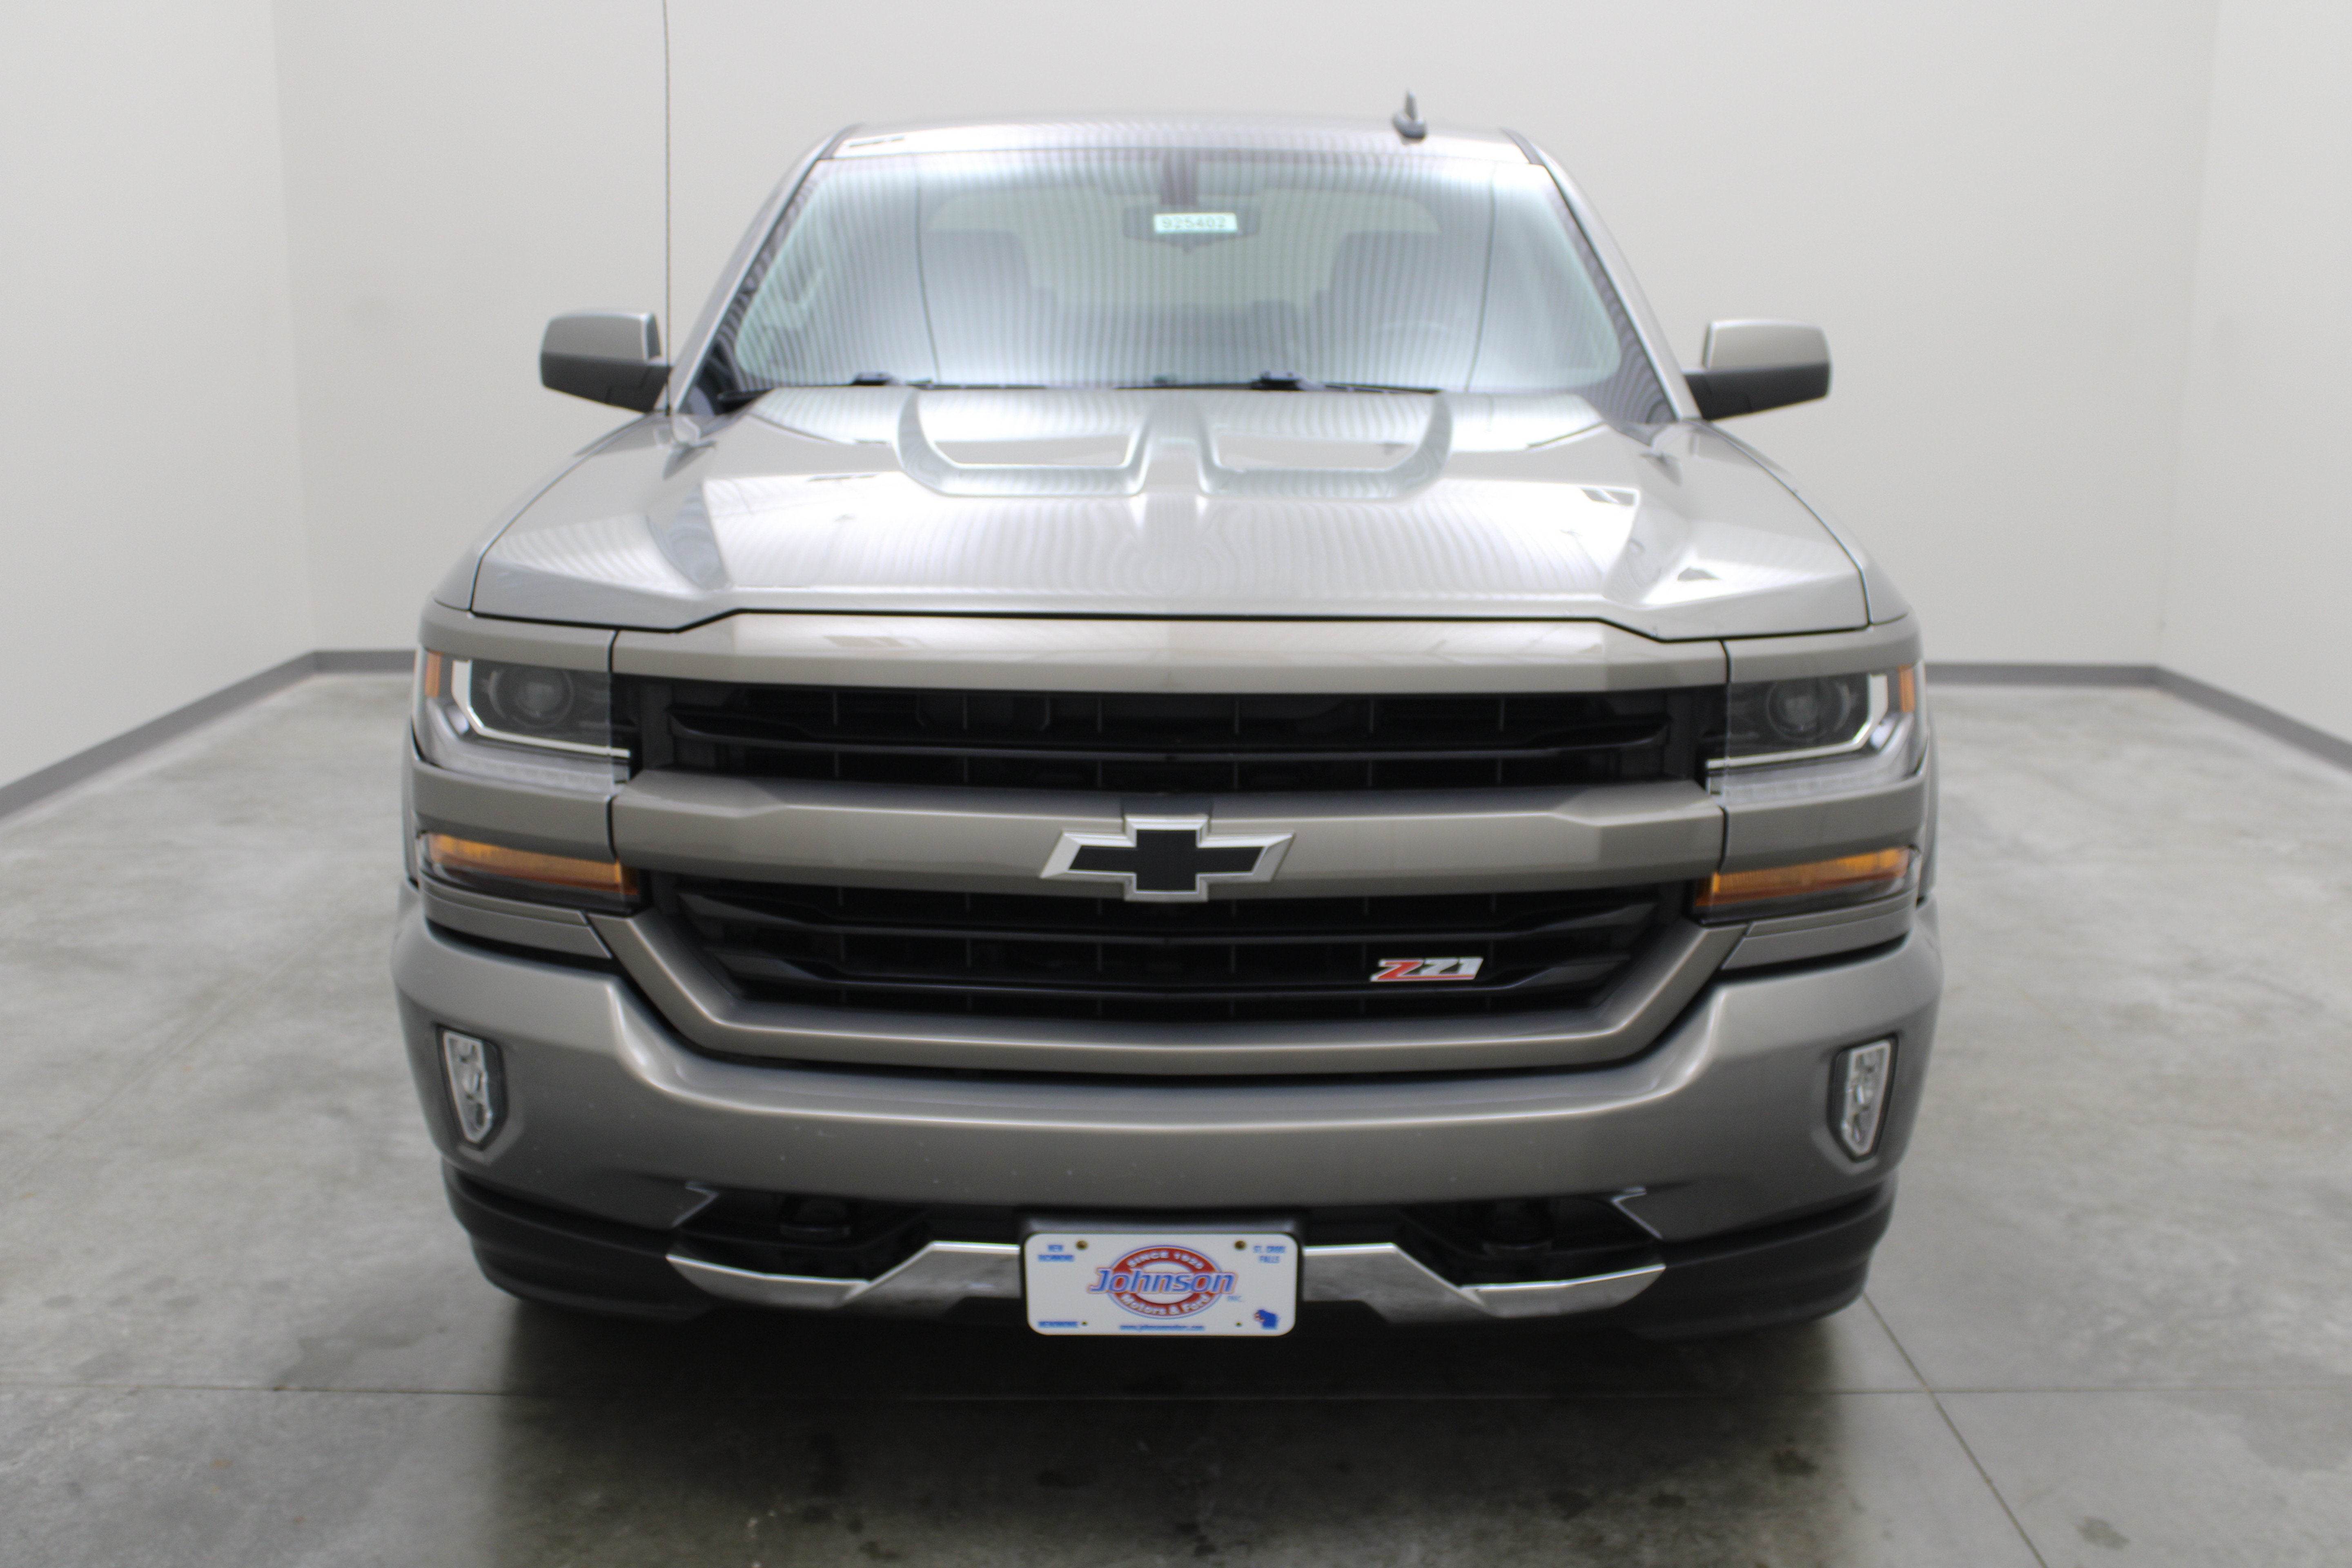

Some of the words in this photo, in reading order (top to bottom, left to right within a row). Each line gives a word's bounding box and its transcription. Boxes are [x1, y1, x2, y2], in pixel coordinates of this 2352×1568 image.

[1161, 215, 1226, 229] 925402
[1370, 957, 1484, 982] Z71
[1127, 1251, 1169, 1267] SINCE
[1088, 1269, 1237, 1293] Johnson
[1121, 1294, 1167, 1315] Motors
